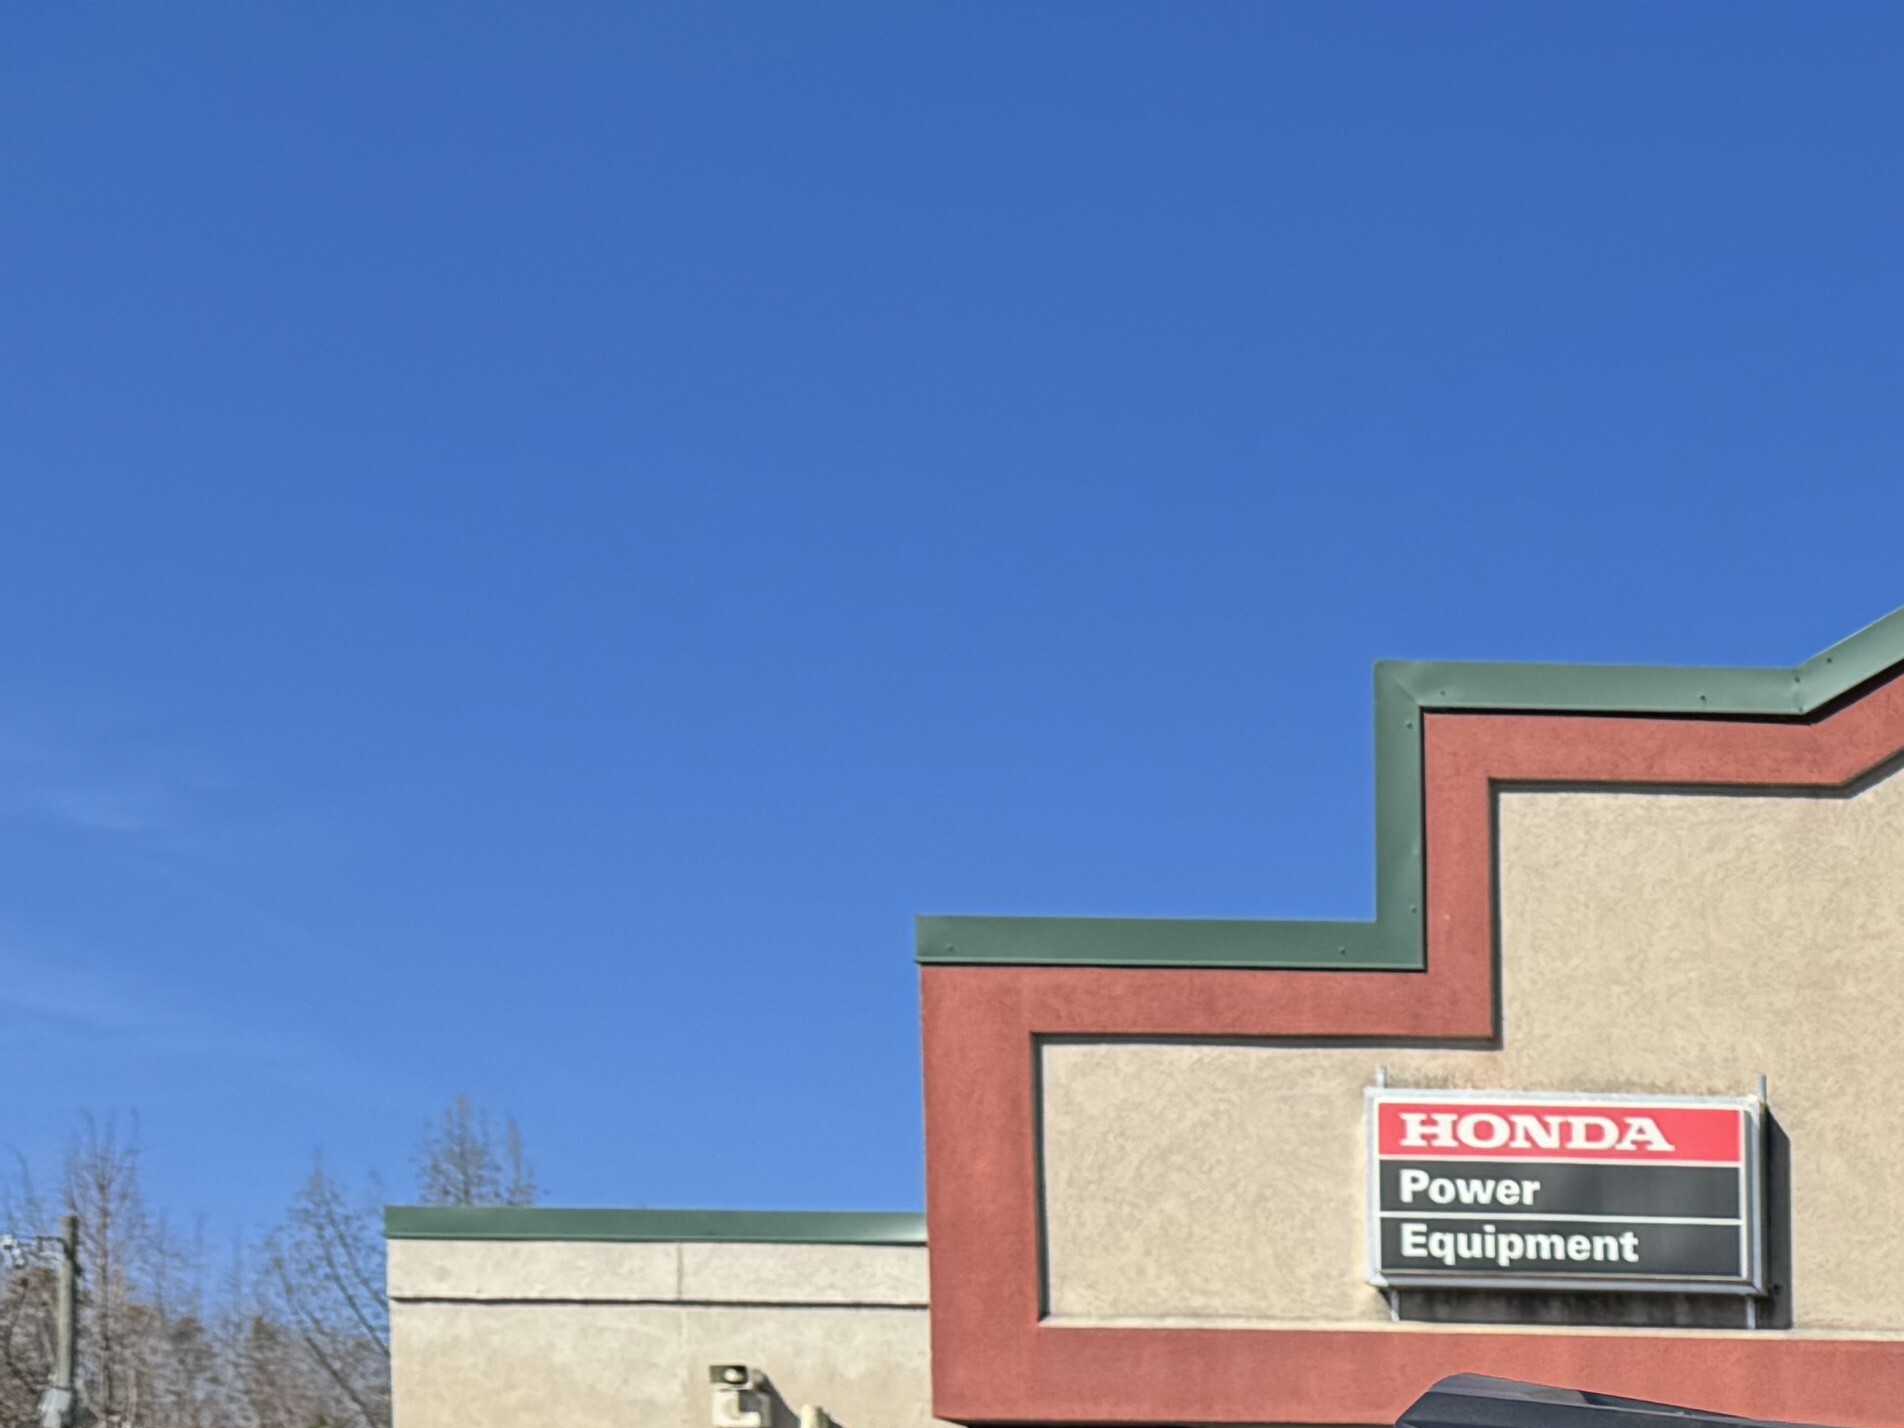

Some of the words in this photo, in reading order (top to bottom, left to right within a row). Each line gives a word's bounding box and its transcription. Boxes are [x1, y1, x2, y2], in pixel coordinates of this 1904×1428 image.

[1399, 1112, 1676, 1152] HONDA
[1399, 1168, 1541, 1206] Power
[1400, 1222, 1640, 1267] Equipment
